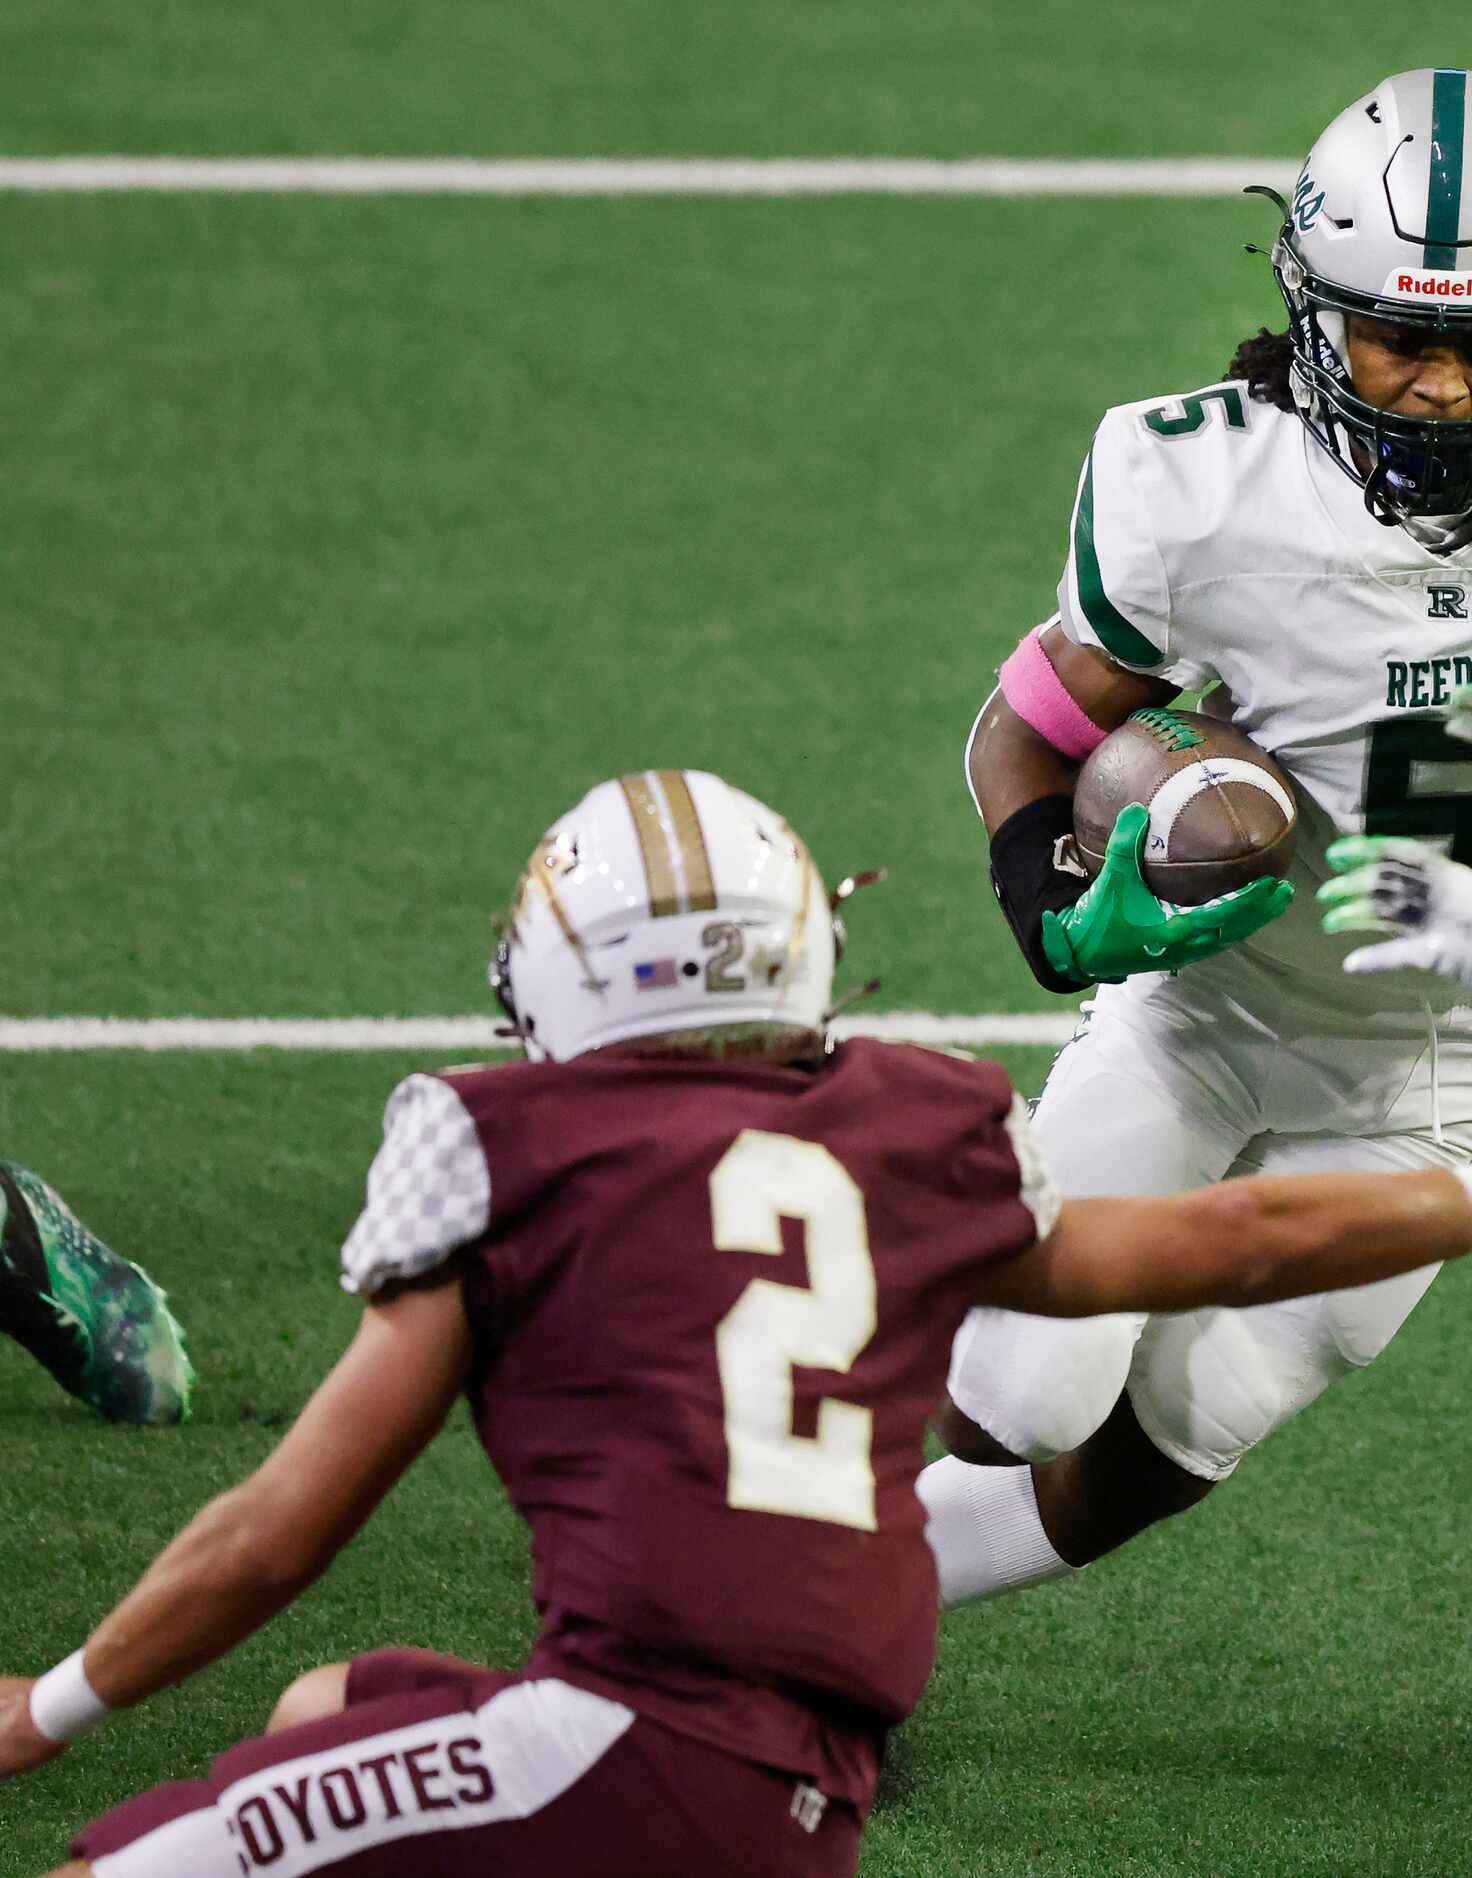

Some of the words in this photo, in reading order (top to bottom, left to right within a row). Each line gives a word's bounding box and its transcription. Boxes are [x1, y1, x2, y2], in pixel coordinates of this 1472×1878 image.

[1140, 387, 1251, 439] 5
[702, 920, 746, 993] 2
[708, 1128, 878, 1533] 2
[226, 1737, 496, 1877] OYOTES
